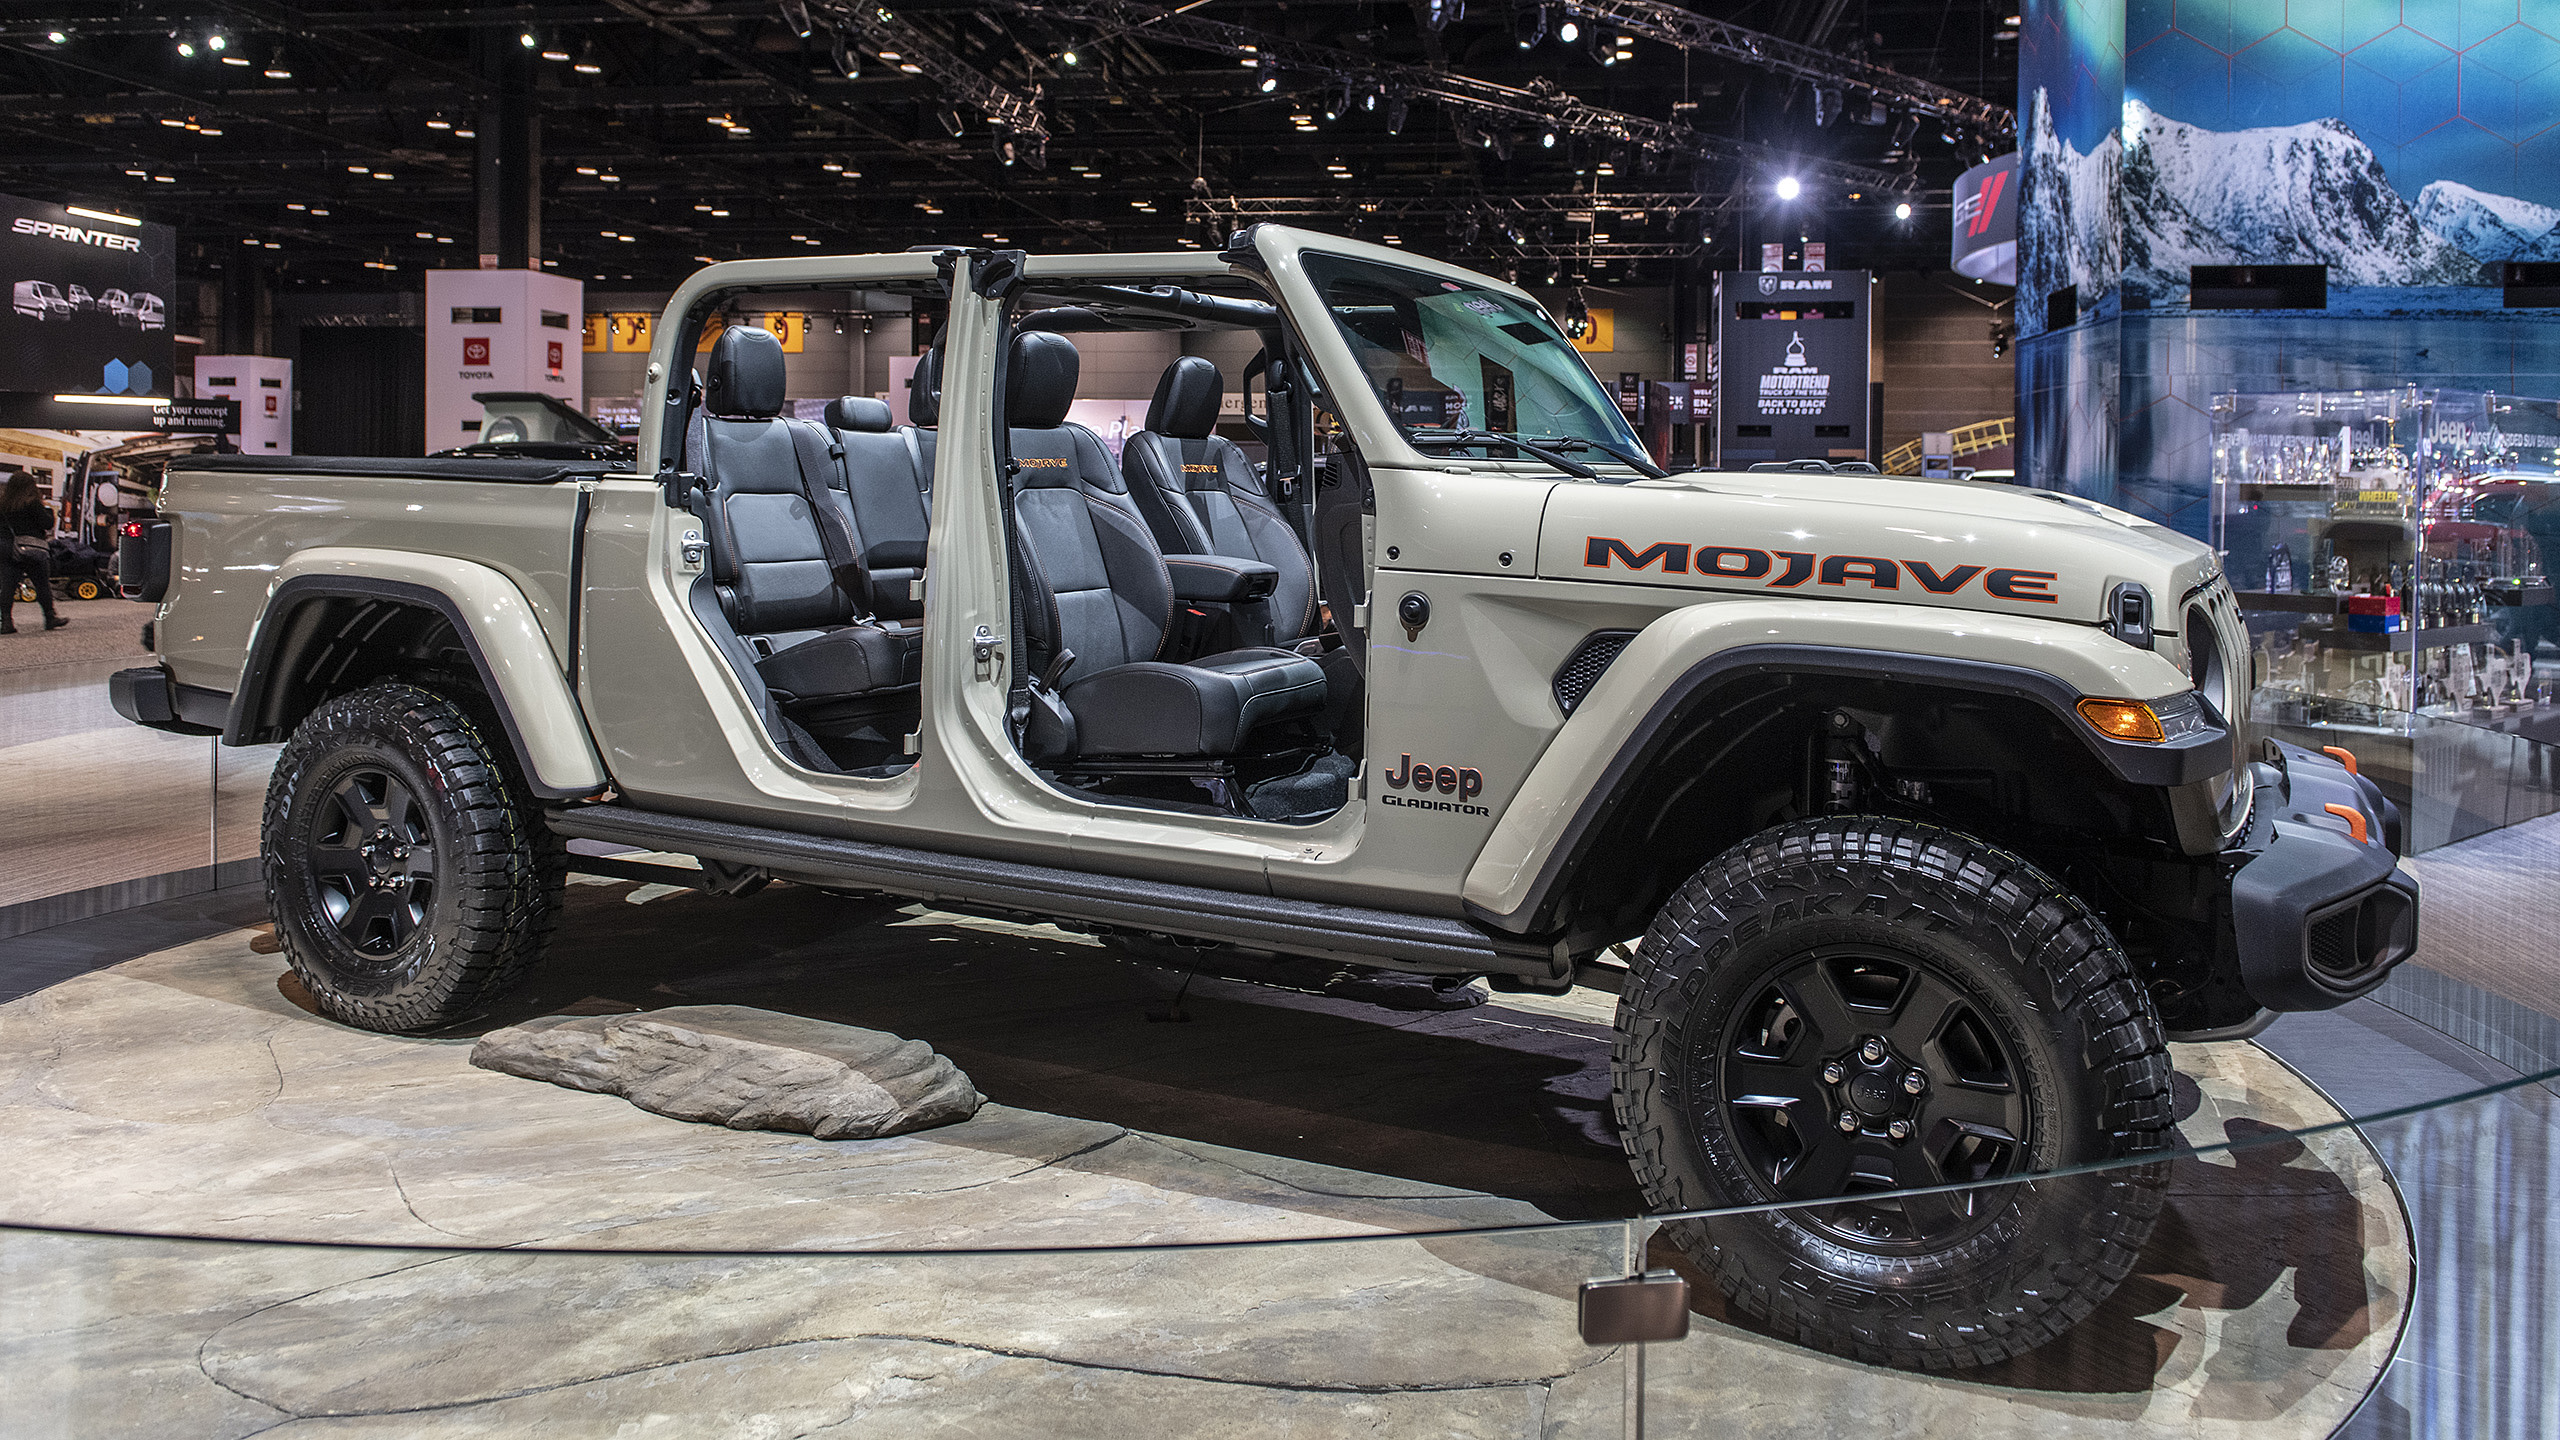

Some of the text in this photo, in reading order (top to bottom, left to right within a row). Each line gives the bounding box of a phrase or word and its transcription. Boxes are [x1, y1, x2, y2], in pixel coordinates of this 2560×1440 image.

[12, 218, 141, 252] SPRINTER
[1780, 280, 1833, 290] RAM
[459, 371, 494, 379] TOYOTA
[1760, 375, 1830, 389] MOTORTREND
[152, 404, 228, 418] Get your concept
[1758, 400, 1826, 408] BACK TO BACK
[152, 416, 226, 428] up and running.
[2429, 411, 2467, 449] Jeep
[1016, 458, 1068, 469] MOJAVE
[1180, 464, 1218, 474] MOJAVE
[1583, 536, 2058, 604] MOJAVE
[1385, 752, 1483, 803] Jeep
[1381, 795, 1490, 817] GLADIATOR
